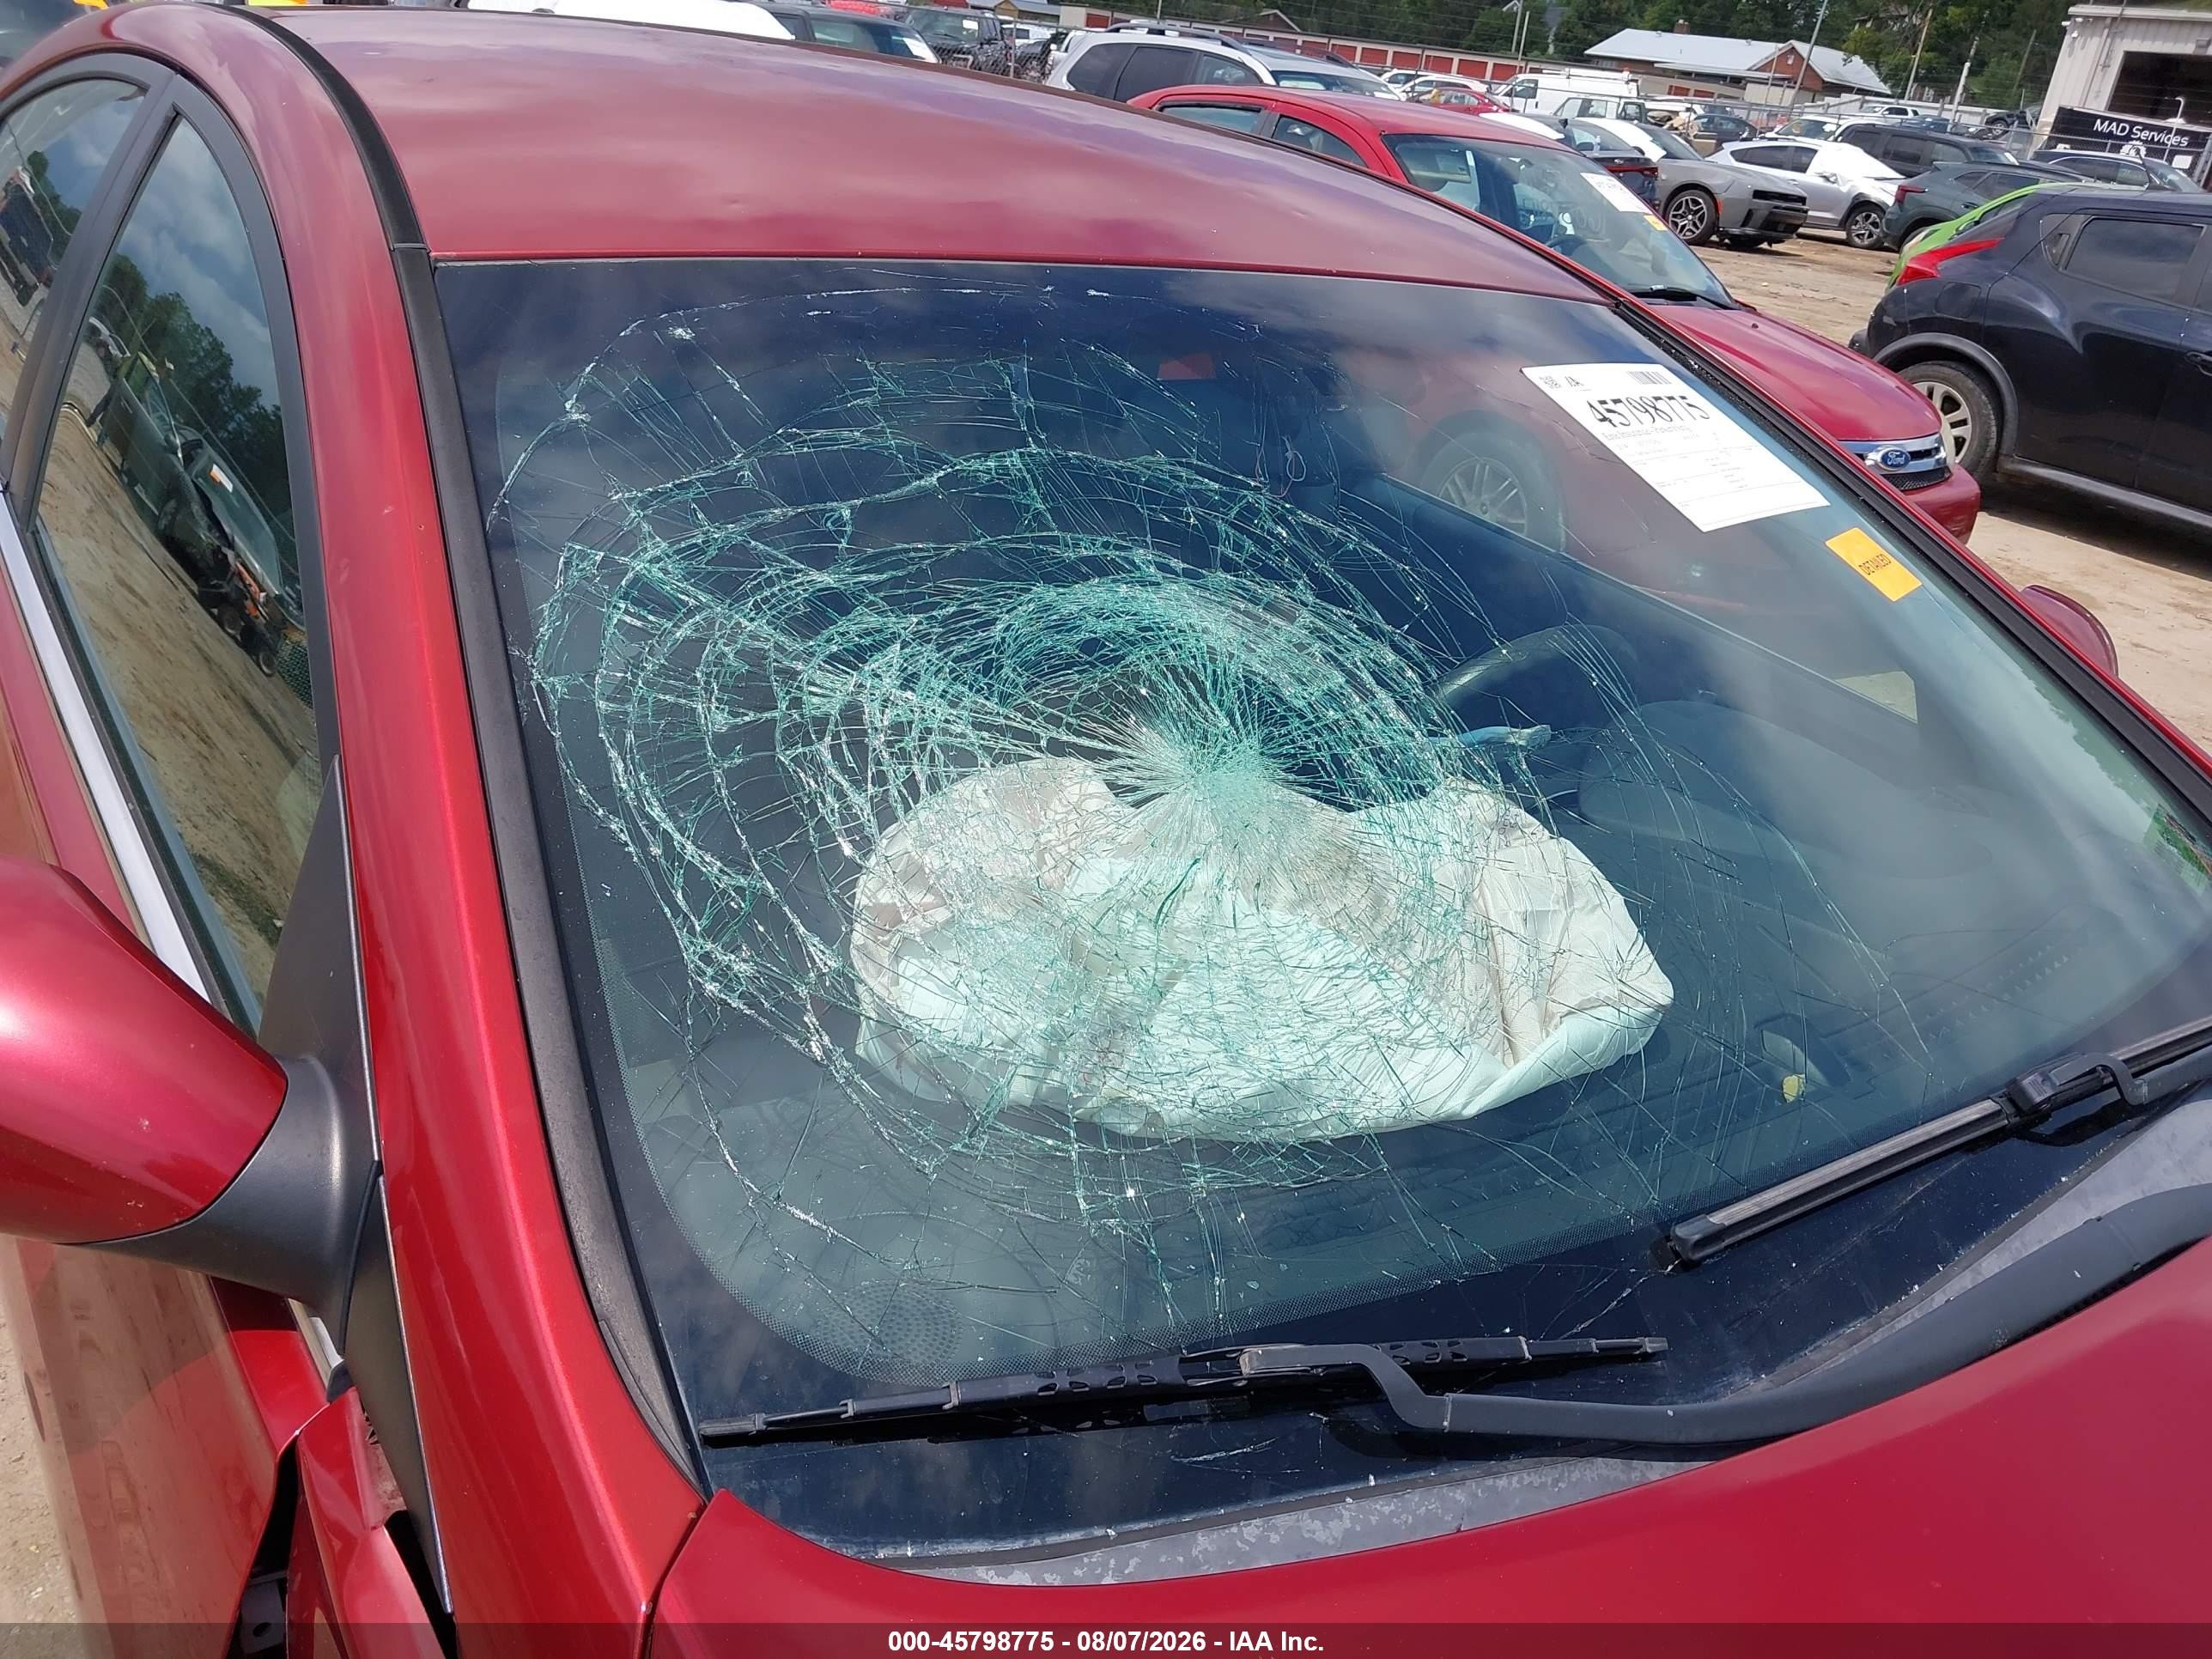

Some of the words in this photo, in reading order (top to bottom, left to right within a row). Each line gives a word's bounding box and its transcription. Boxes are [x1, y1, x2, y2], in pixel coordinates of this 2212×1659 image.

[2093, 118, 2130, 137] MAD
[2130, 125, 2189, 147] Services
[1587, 395, 1711, 428] 45798775
[1887, 451, 1905, 465] Ford
[1858, 554, 1892, 575] DETAILED
